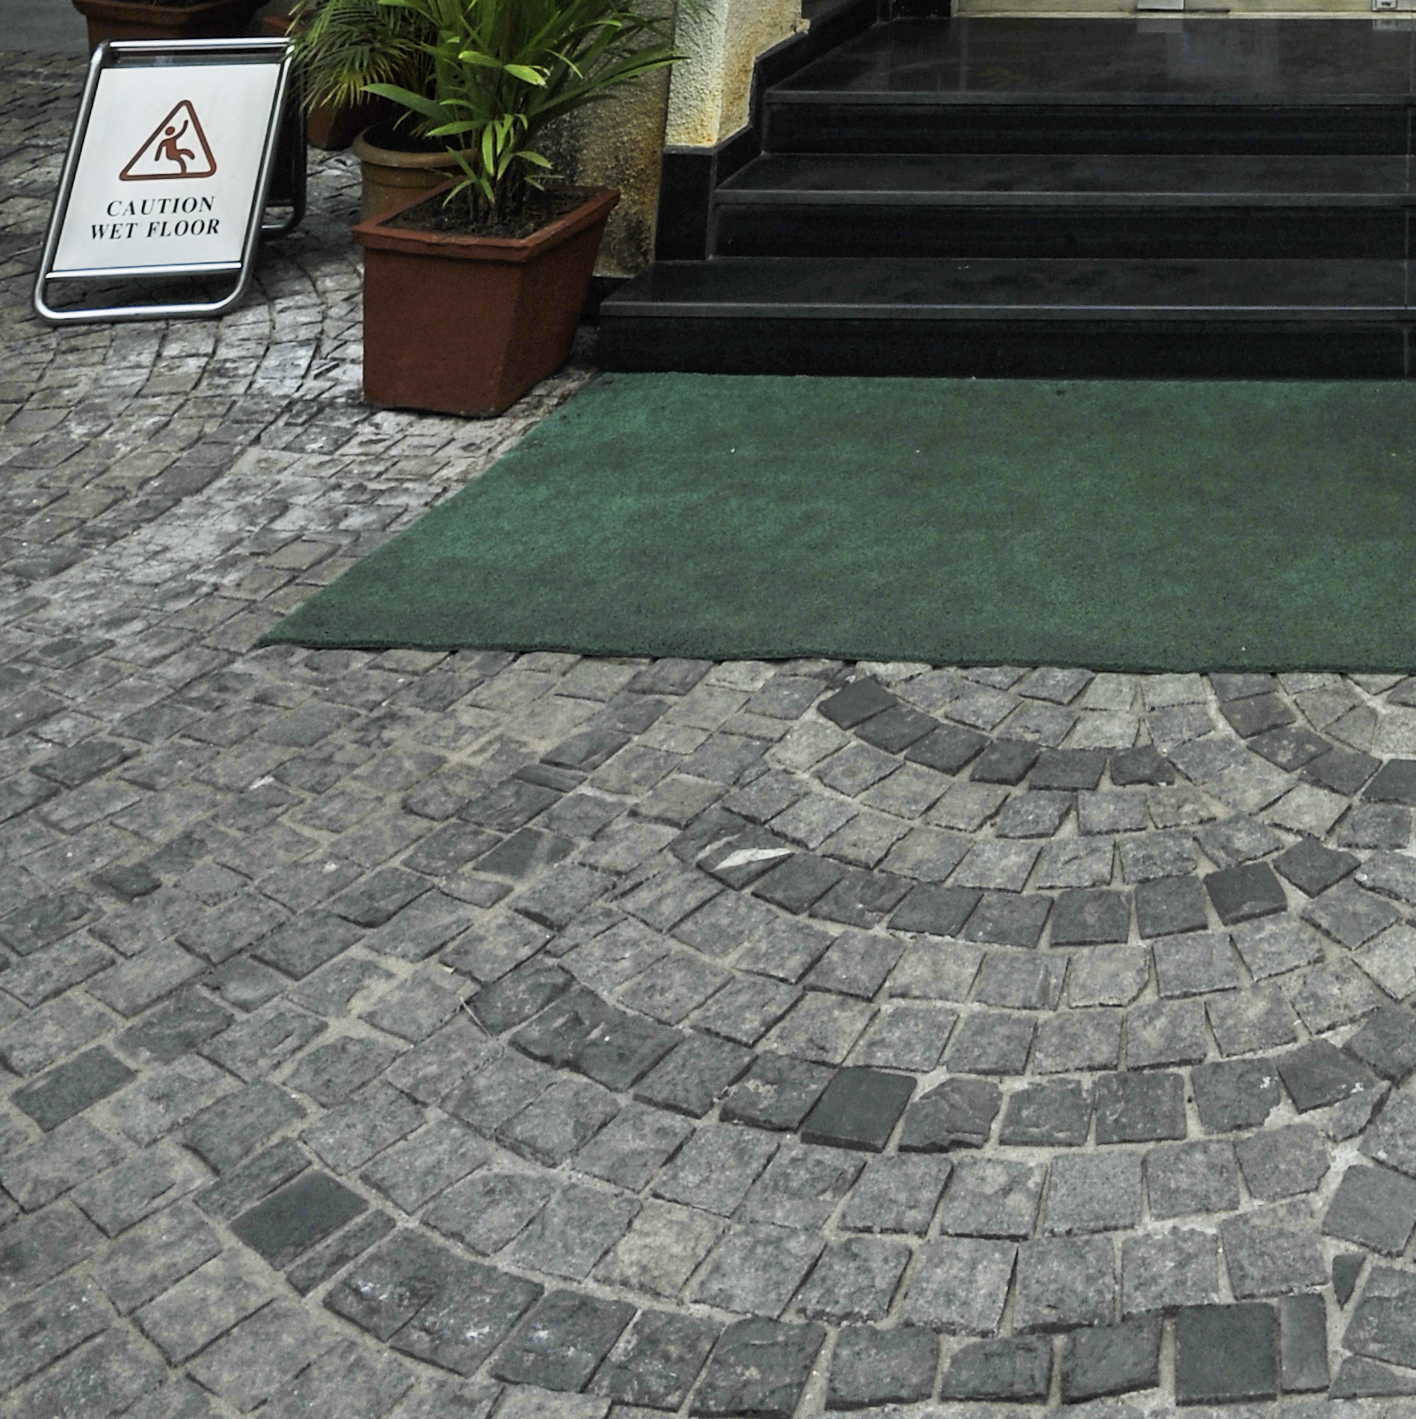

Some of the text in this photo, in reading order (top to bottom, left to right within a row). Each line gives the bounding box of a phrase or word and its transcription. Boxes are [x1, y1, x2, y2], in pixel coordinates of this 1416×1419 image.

[106, 196, 216, 217] CAUTION
[91, 219, 220, 240] WET FLOOR
